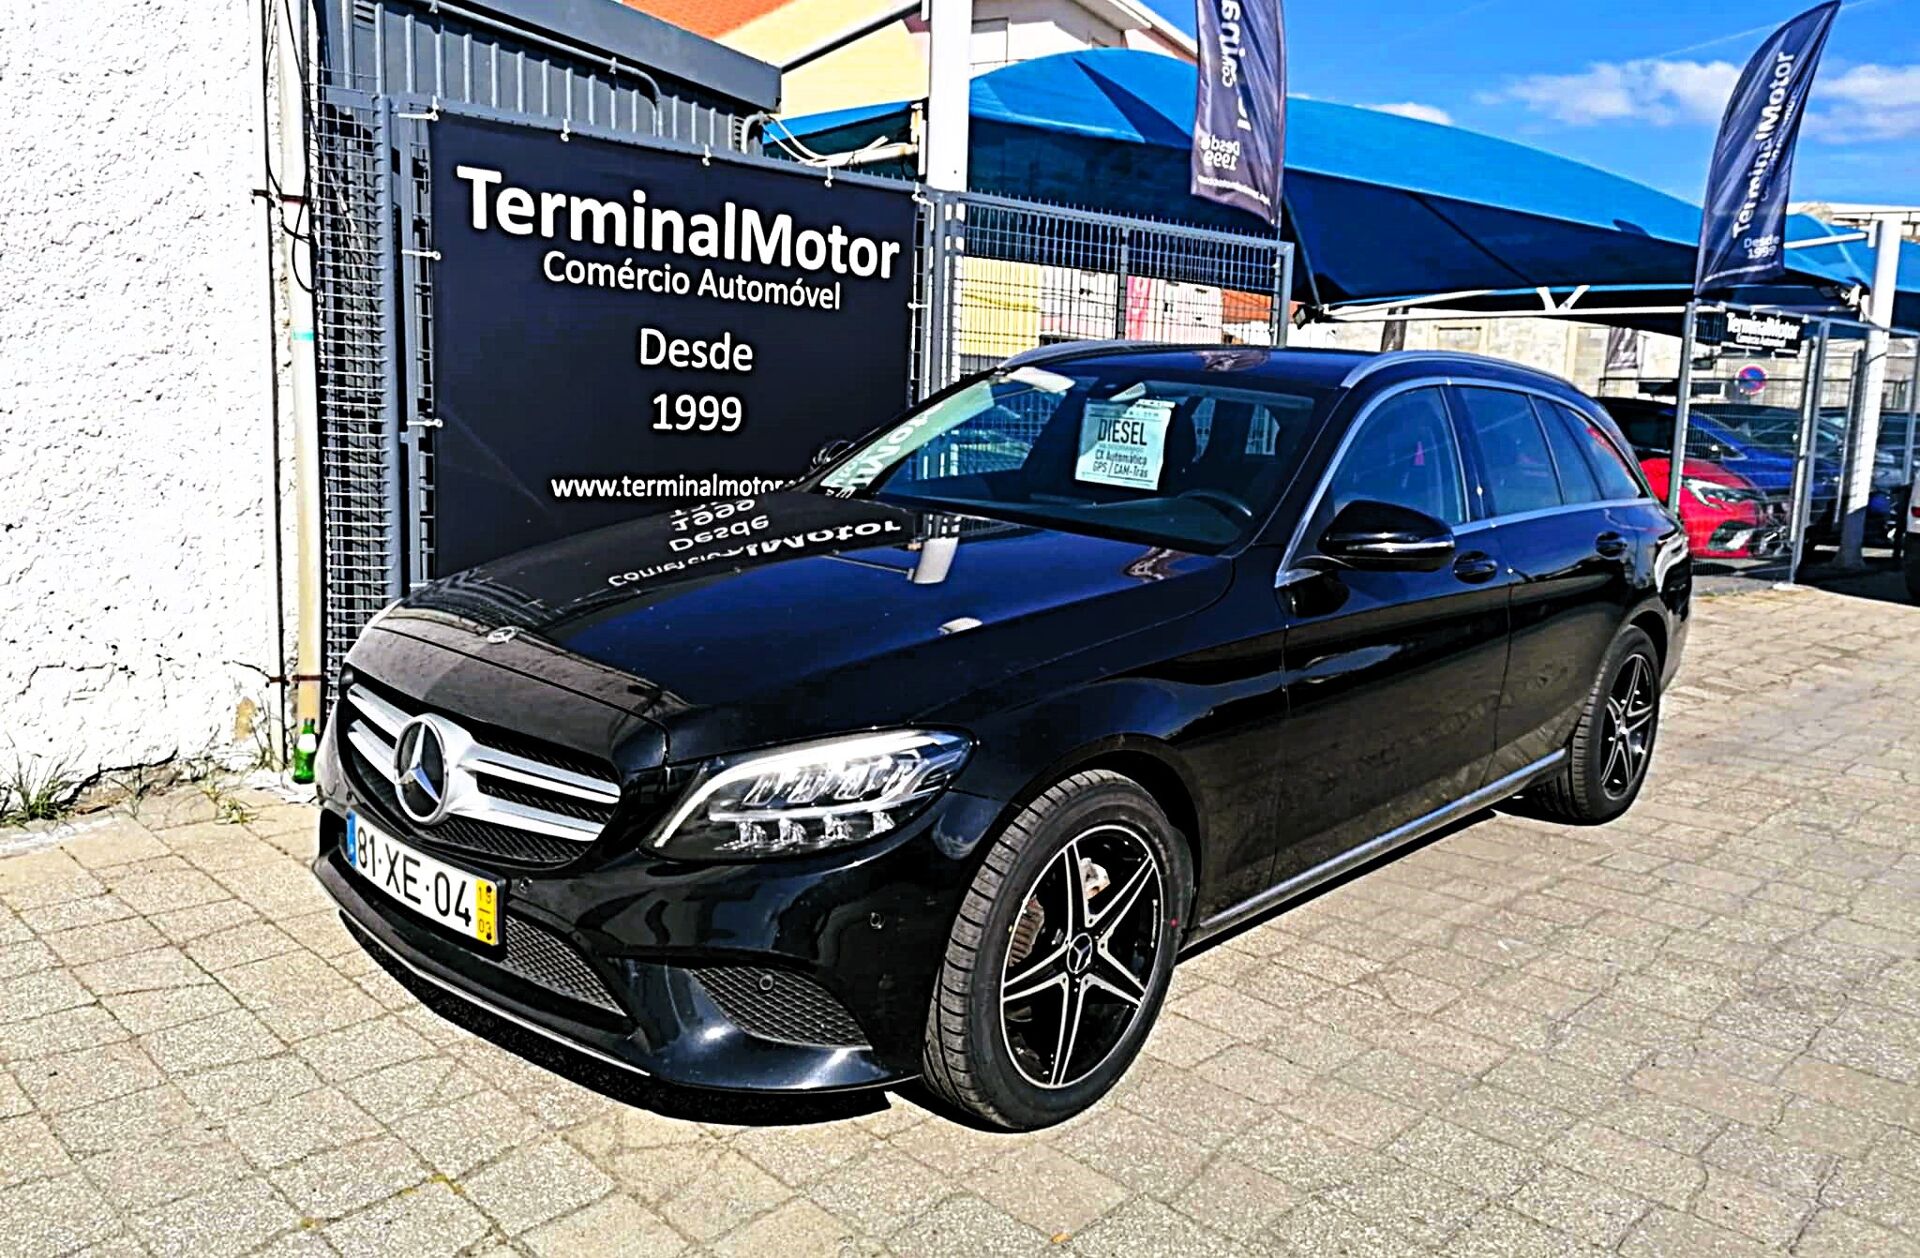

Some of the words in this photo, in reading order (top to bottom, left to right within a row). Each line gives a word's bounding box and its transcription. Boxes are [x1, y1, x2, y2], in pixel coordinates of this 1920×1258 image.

[456, 165, 900, 279] TerminalMotor
[543, 250, 691, 295] Comércio
[697, 268, 841, 310] Automóvel
[640, 327, 754, 372] Desde
[652, 393, 743, 432] 1999
[1098, 418, 1147, 446] DIESEL
[1093, 461, 1107, 473] GPS
